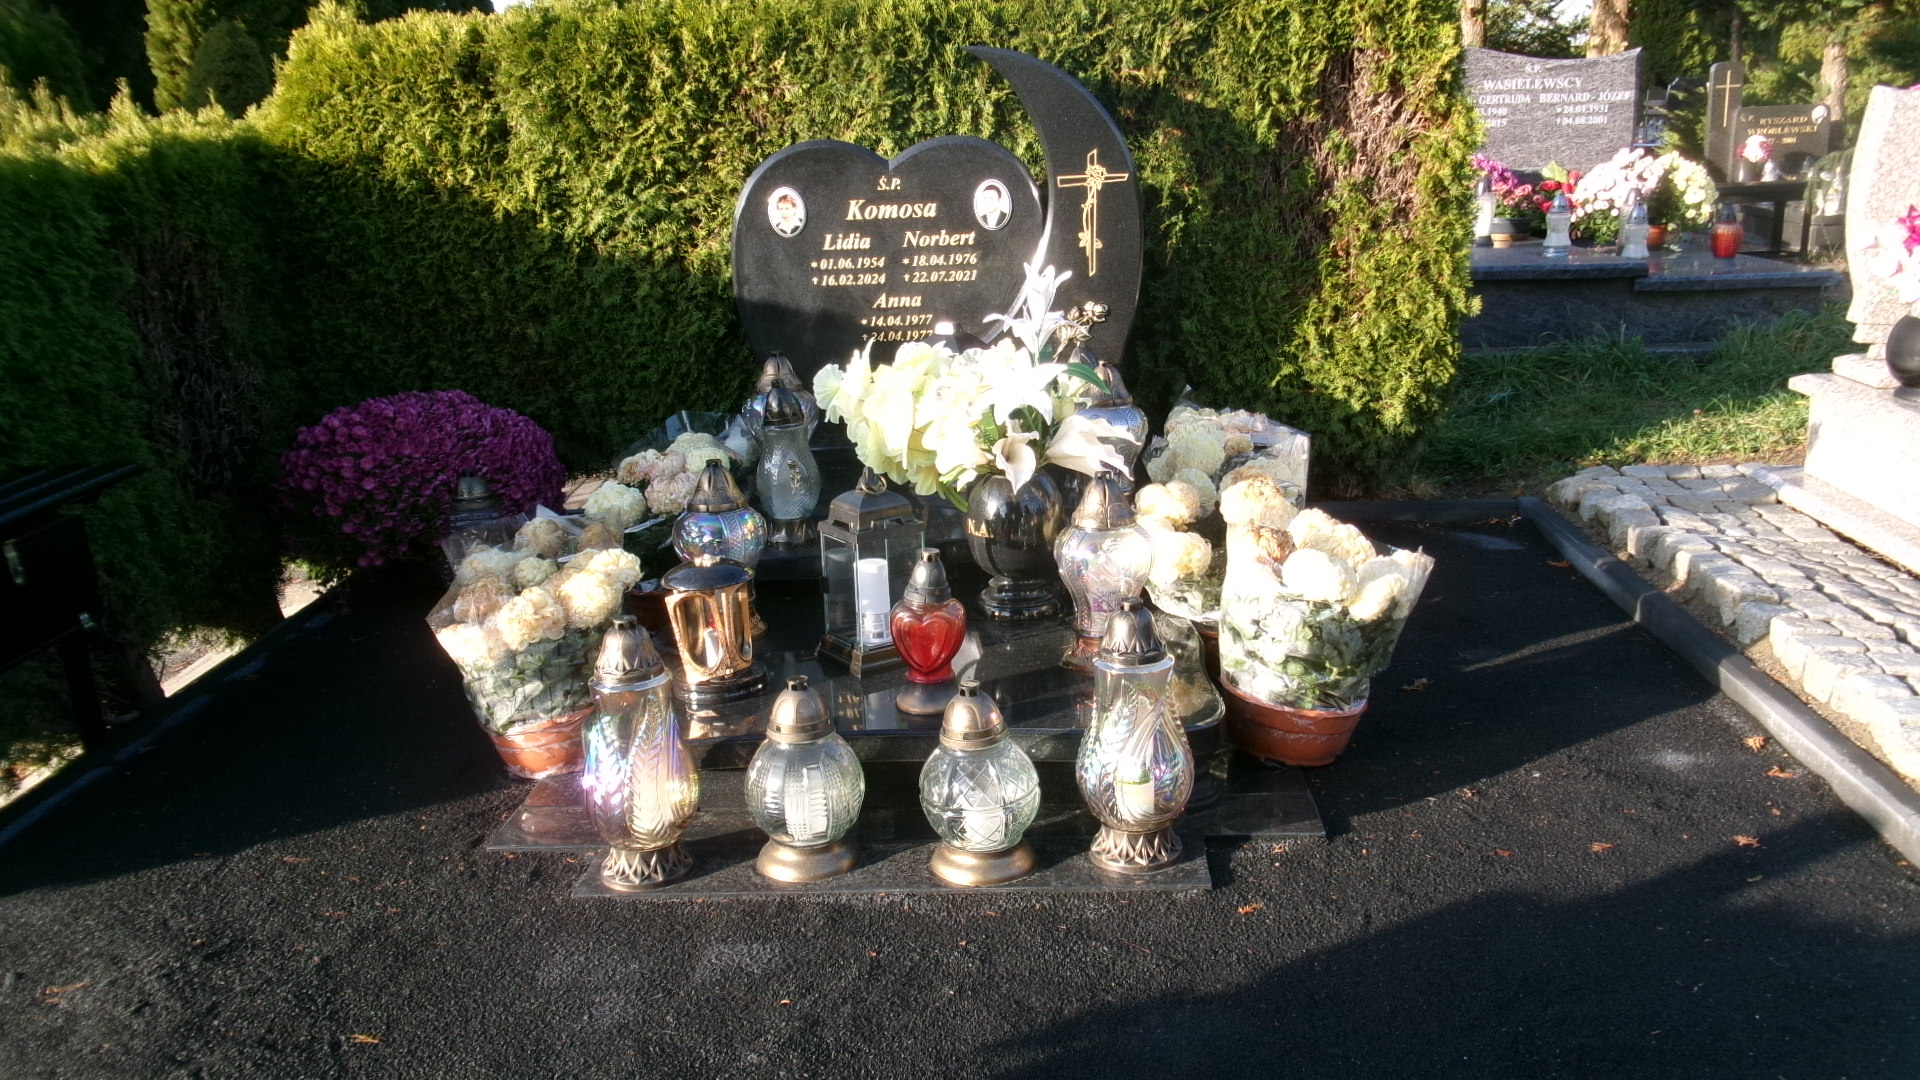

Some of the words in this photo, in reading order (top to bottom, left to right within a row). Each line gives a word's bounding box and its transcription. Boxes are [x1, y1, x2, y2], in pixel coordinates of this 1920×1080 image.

[1482, 77, 1584, 91] WASIELEWSCY
[1478, 94, 1531, 104] GERTRUDA
[845, 199, 938, 221] Komosa
[823, 232, 872, 251] Lidia
[902, 229, 976, 249] Norbert
[820, 256, 886, 270] 01.06.1954
[911, 252, 978, 267] 18.04.1976
[820, 272, 887, 287] 16.02.2024
[911, 270, 979, 284] 22.07.2021
[872, 292, 922, 309] Anna
[870, 314, 933, 327] 14.04.1977
